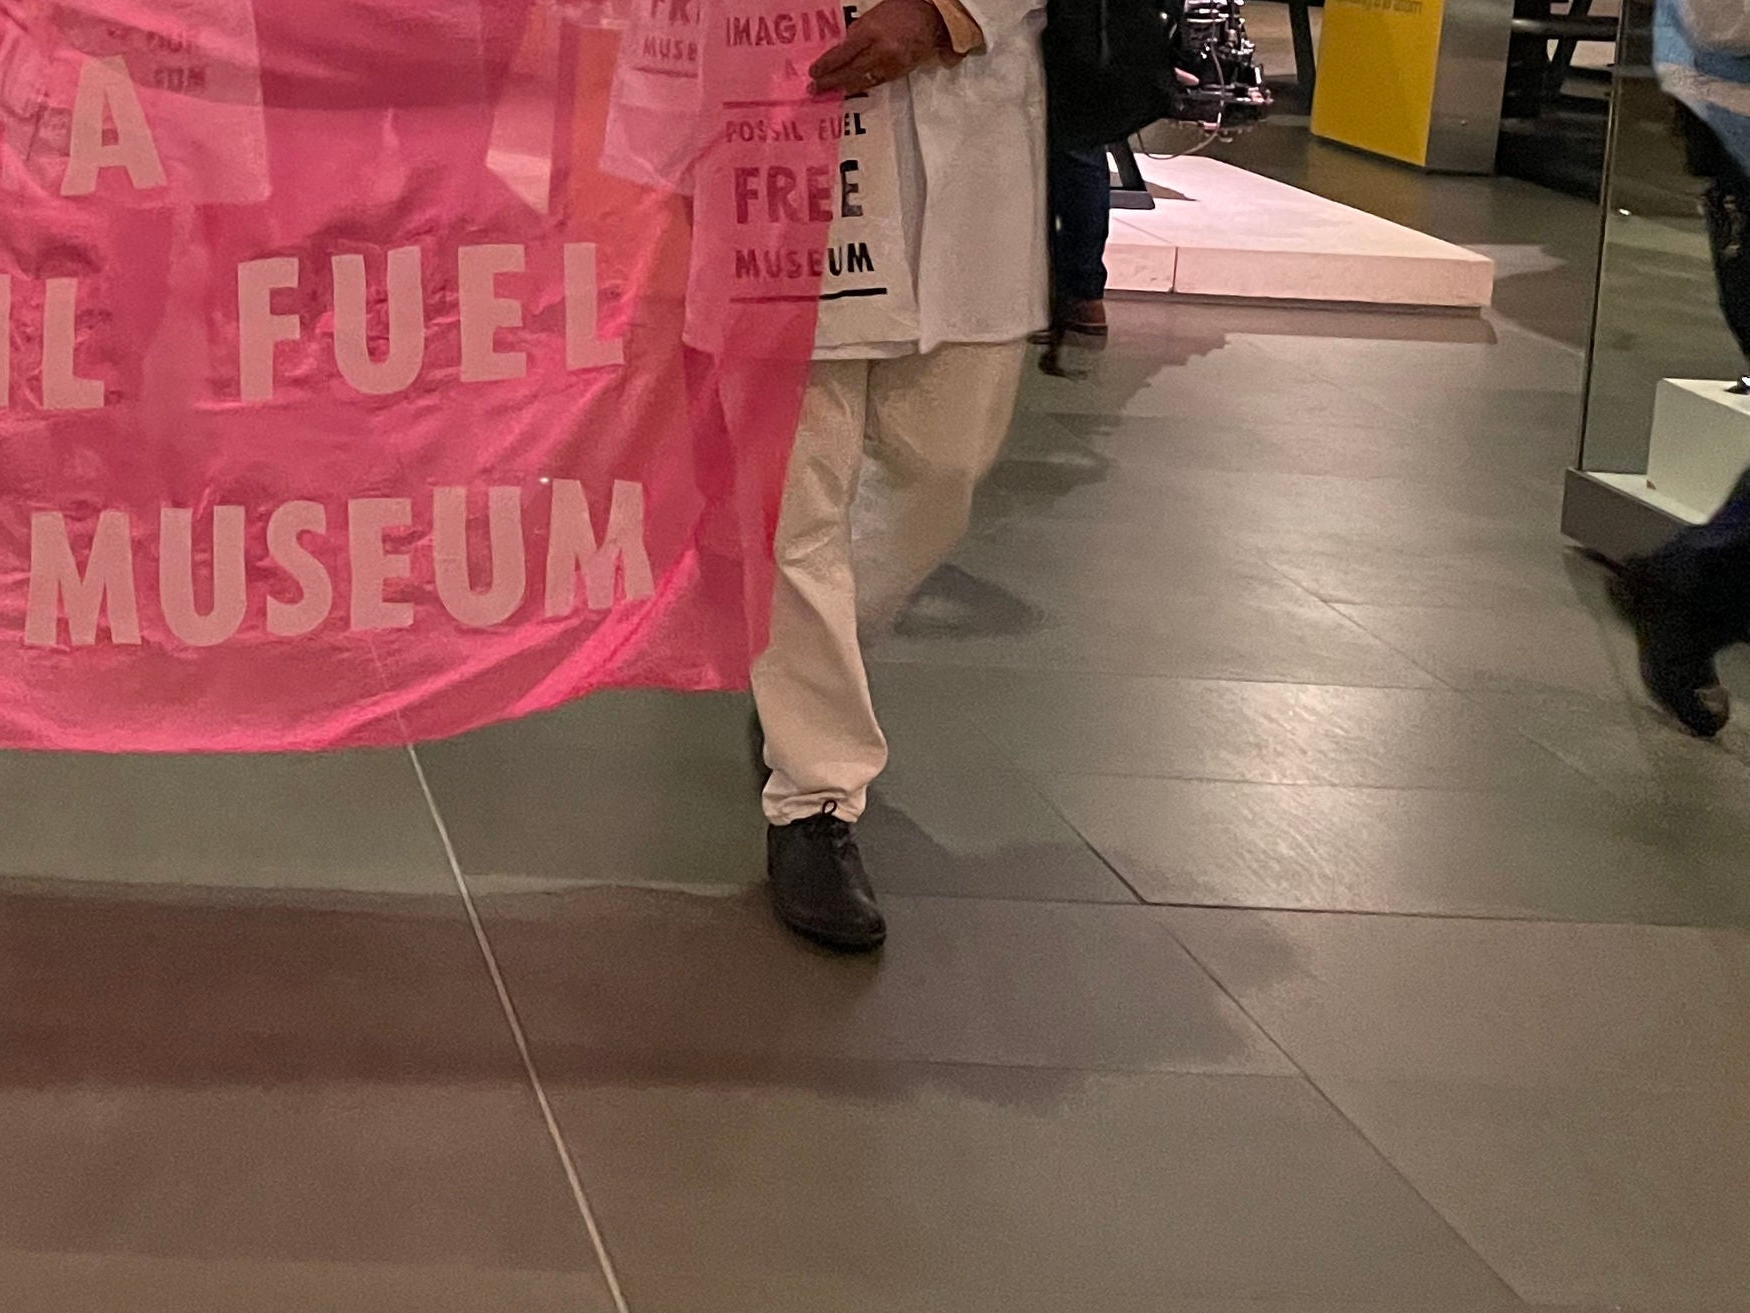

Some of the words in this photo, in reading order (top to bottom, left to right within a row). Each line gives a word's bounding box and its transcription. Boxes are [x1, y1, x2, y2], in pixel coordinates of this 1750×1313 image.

[60, 53, 168, 198] A
[725, 119, 804, 143] FOSSIL
[817, 112, 867, 140] FUEL
[735, 159, 864, 224] FREE
[735, 243, 875, 280] MUSEUM
[237, 241, 626, 401] FUEL
[24, 479, 654, 649] MUSEUM
